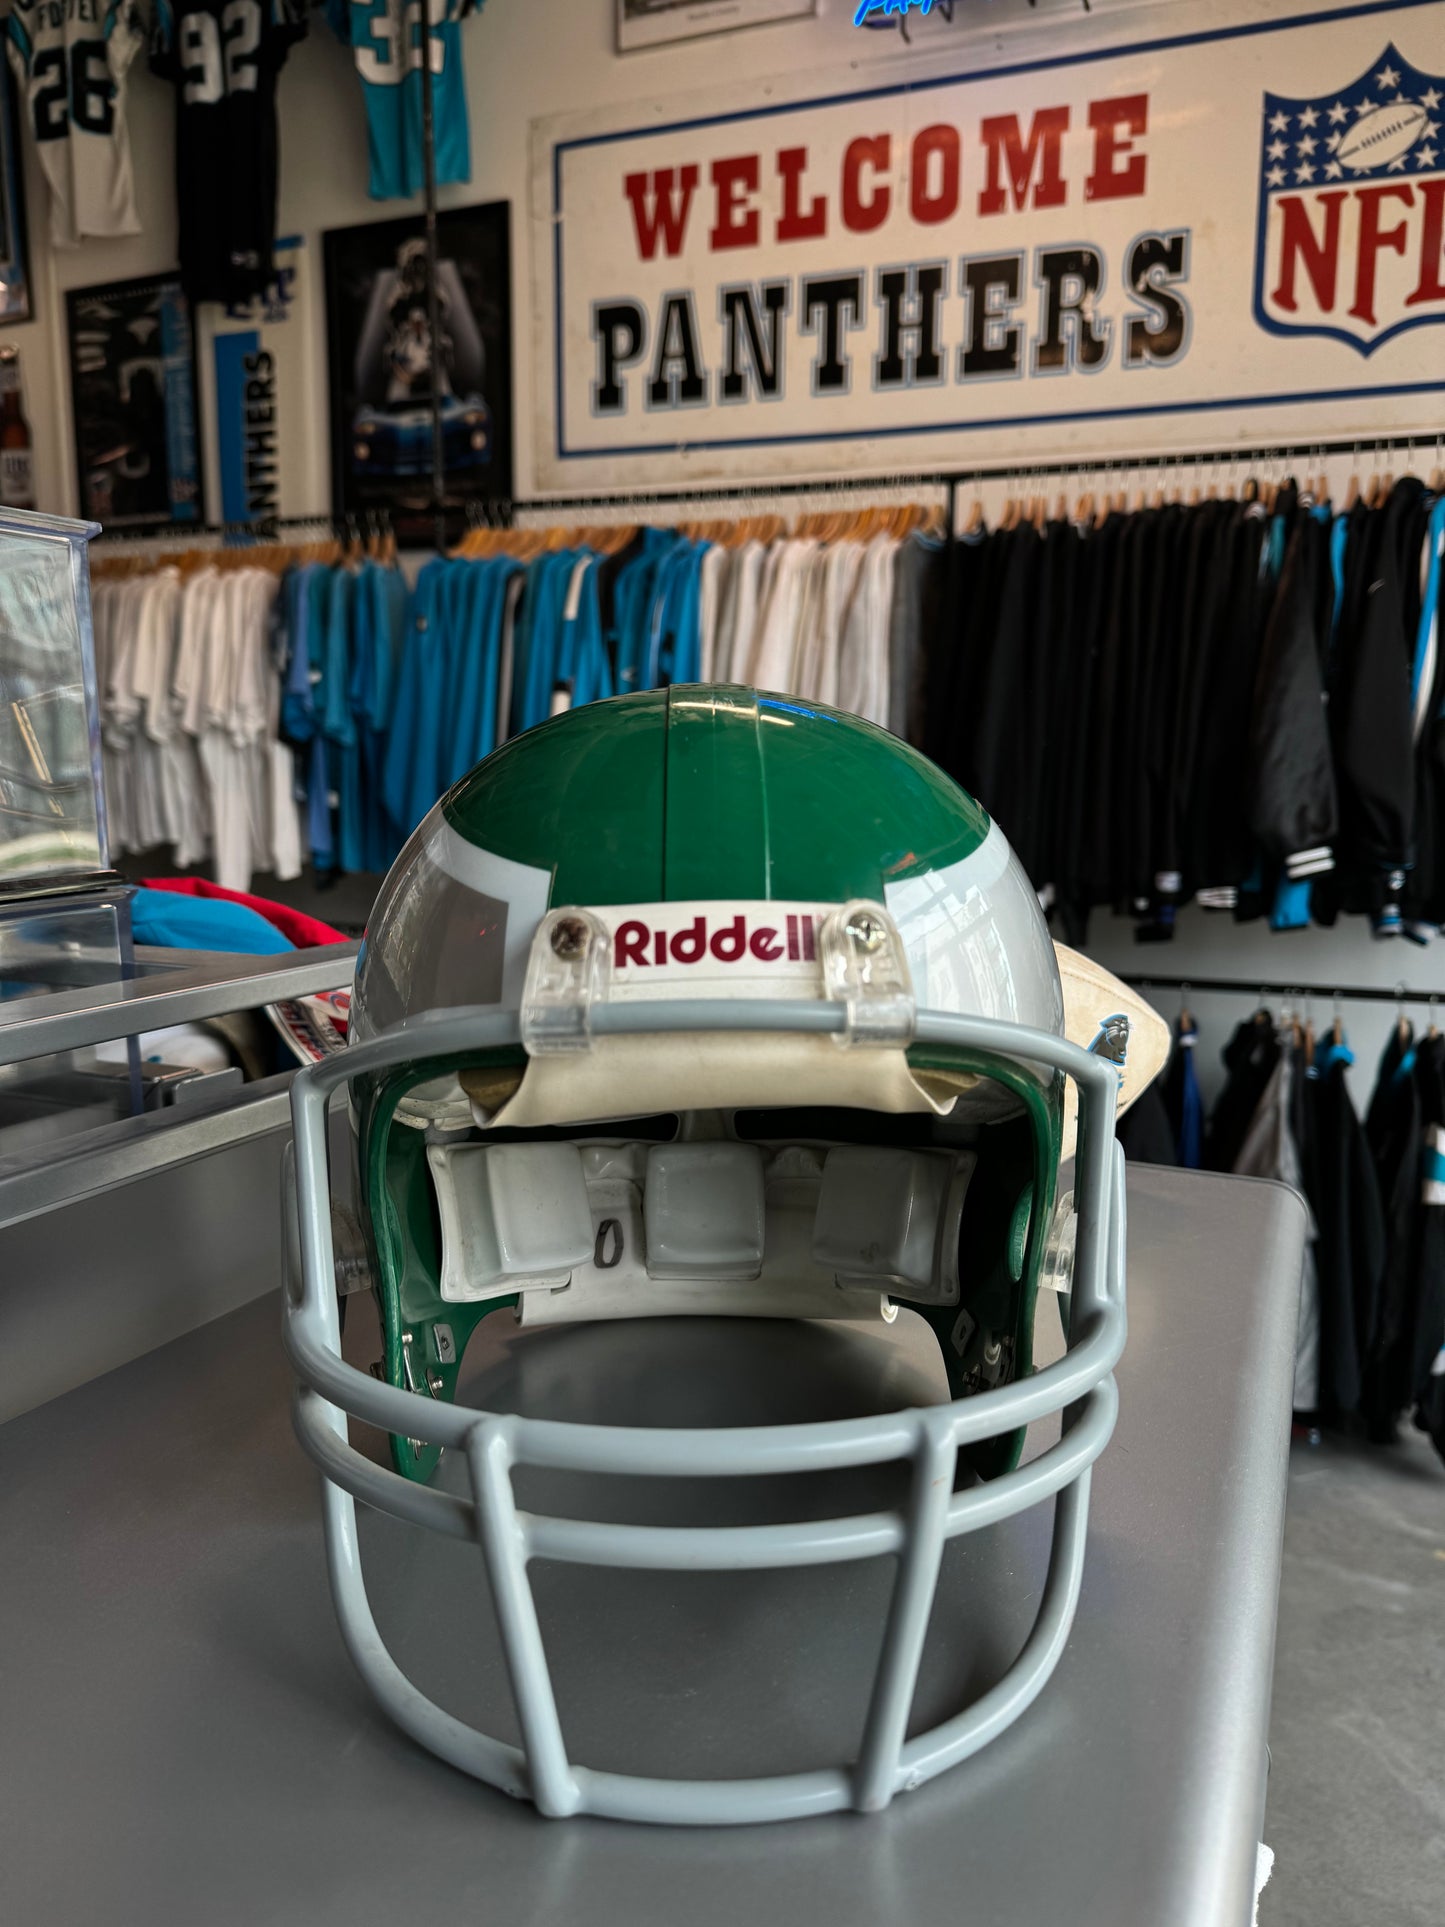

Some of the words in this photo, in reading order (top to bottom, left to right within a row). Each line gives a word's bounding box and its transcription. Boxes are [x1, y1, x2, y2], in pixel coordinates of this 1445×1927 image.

[33, 38, 118, 142] 26
[181, 1, 261, 103] 92
[624, 92, 1149, 261] WELCOME
[590, 226, 1193, 417] PANTHERS
[243, 350, 279, 539] ANTHERS
[613, 914, 816, 968] Riddell
